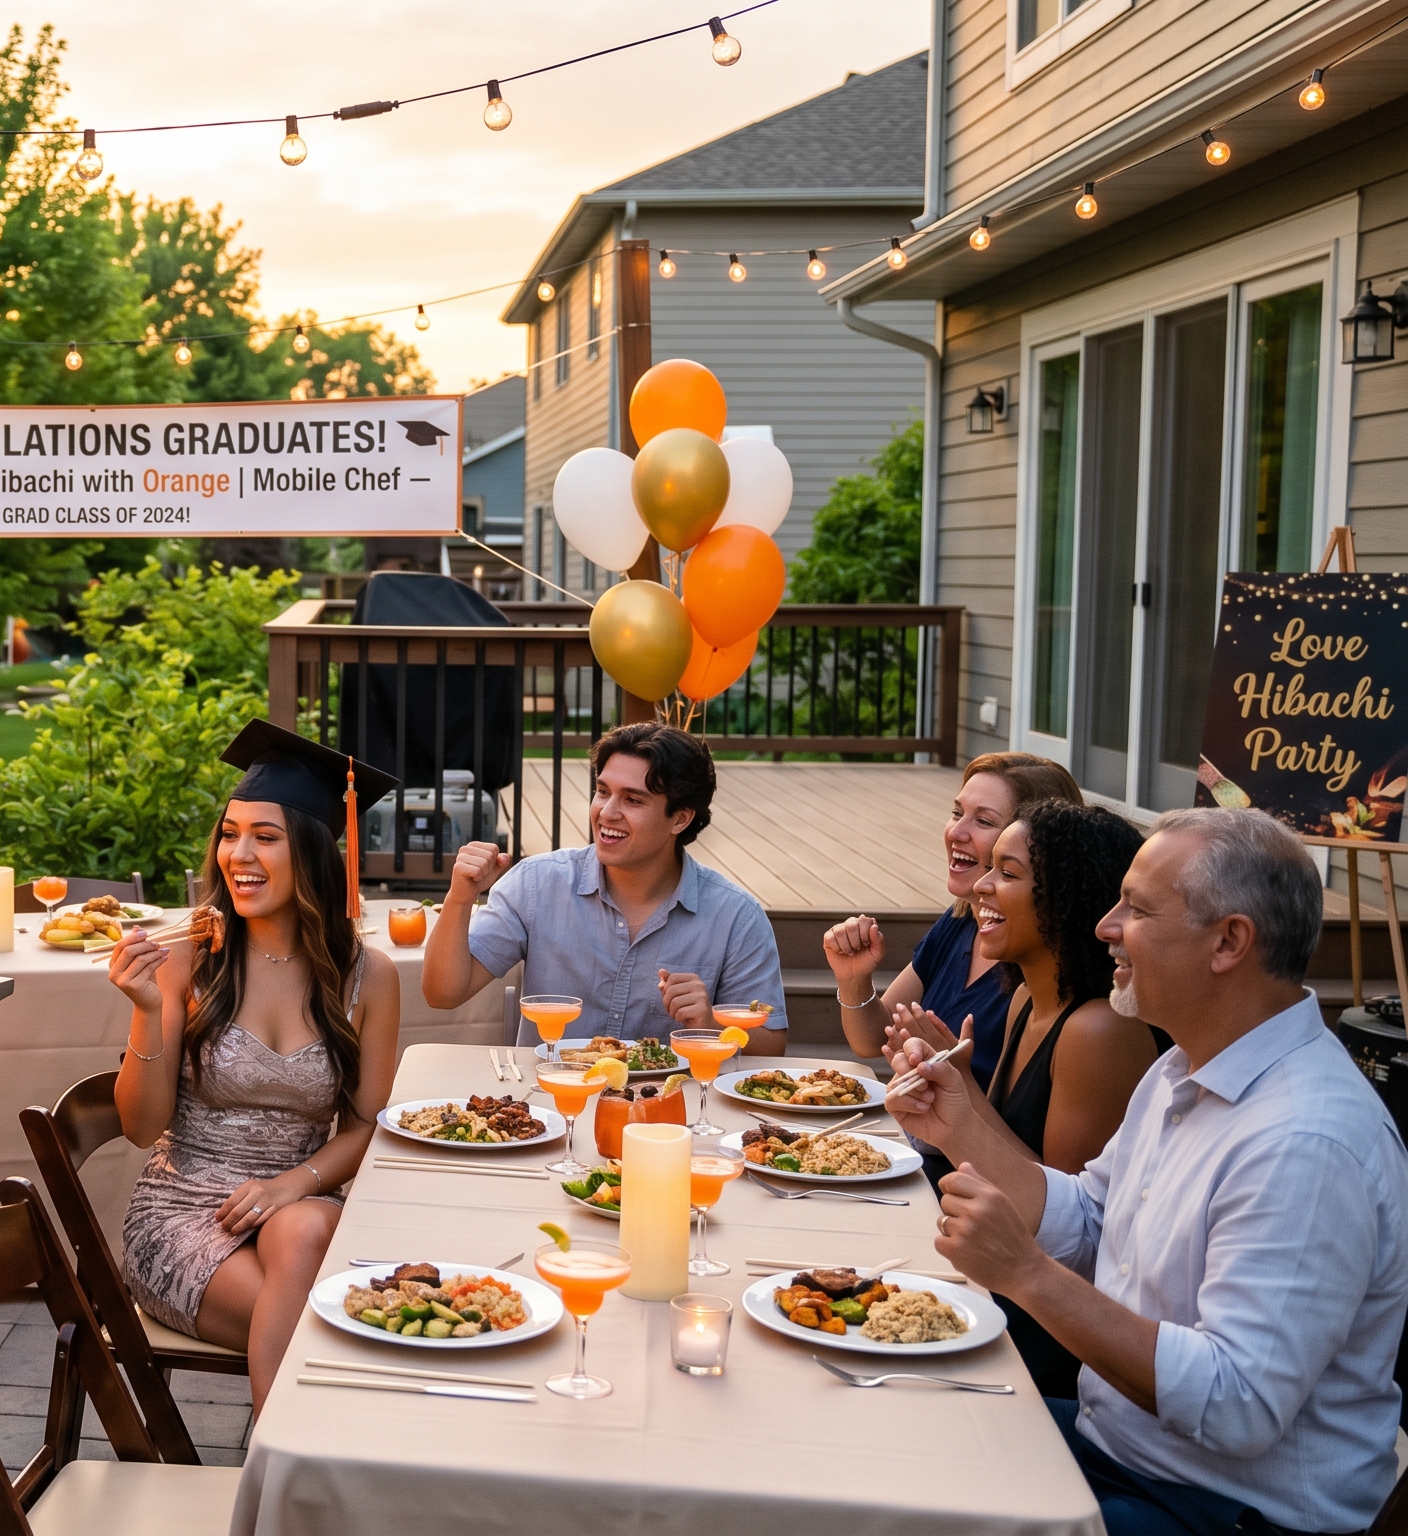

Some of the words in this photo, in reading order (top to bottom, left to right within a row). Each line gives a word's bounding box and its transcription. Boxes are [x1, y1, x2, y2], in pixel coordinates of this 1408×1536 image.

[163, 420, 386, 456] GRADUATES!
[82, 468, 134, 493] with
[143, 468, 230, 498] Orange
[253, 466, 336, 492] Mobile
[344, 466, 401, 492] Chef
[2, 507, 50, 524] GRAD
[55, 506, 111, 524] CLASS
[116, 506, 138, 524] OF
[143, 506, 190, 524] 2024!
[1270, 617, 1369, 668] Love
[1233, 672, 1395, 720] Hibachi
[1244, 726, 1362, 793] Party
